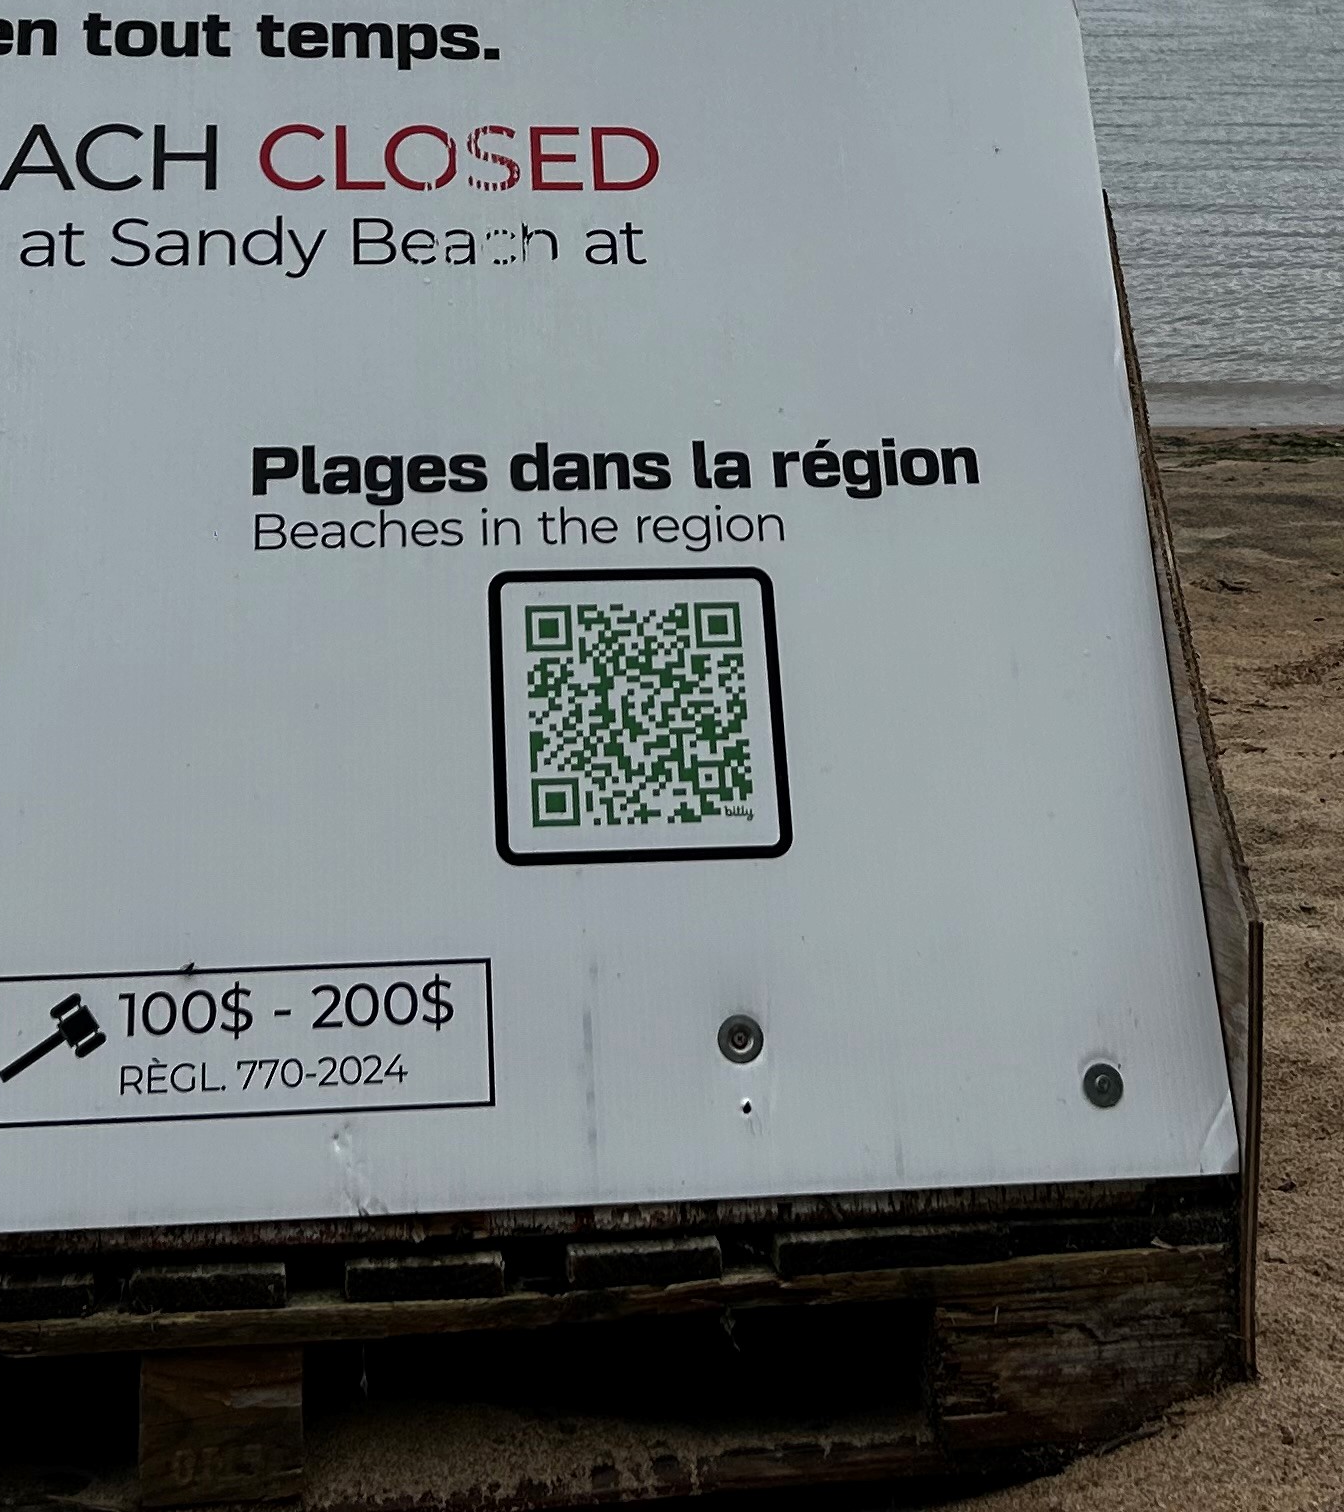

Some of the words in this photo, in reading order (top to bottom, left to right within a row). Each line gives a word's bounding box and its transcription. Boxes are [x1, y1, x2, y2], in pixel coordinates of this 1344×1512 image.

[83, 13, 231, 57] tout
[257, 15, 499, 70] temps.
[260, 124, 659, 191] CLOSED
[20, 223, 85, 267] at
[111, 216, 327, 278] Sandy
[586, 222, 647, 264] at
[253, 445, 487, 506] Plages
[510, 442, 671, 491] dans
[692, 441, 751, 489] la
[773, 438, 979, 499] région
[255, 509, 463, 550] Beaches
[482, 508, 520, 545] in
[538, 506, 618, 545] the
[637, 505, 784, 552] region
[119, 981, 253, 1039] 100$
[312, 973, 453, 1031] 200$
[121, 1058, 226, 1095] RÈGL.
[237, 1054, 408, 1090] 770-2024
